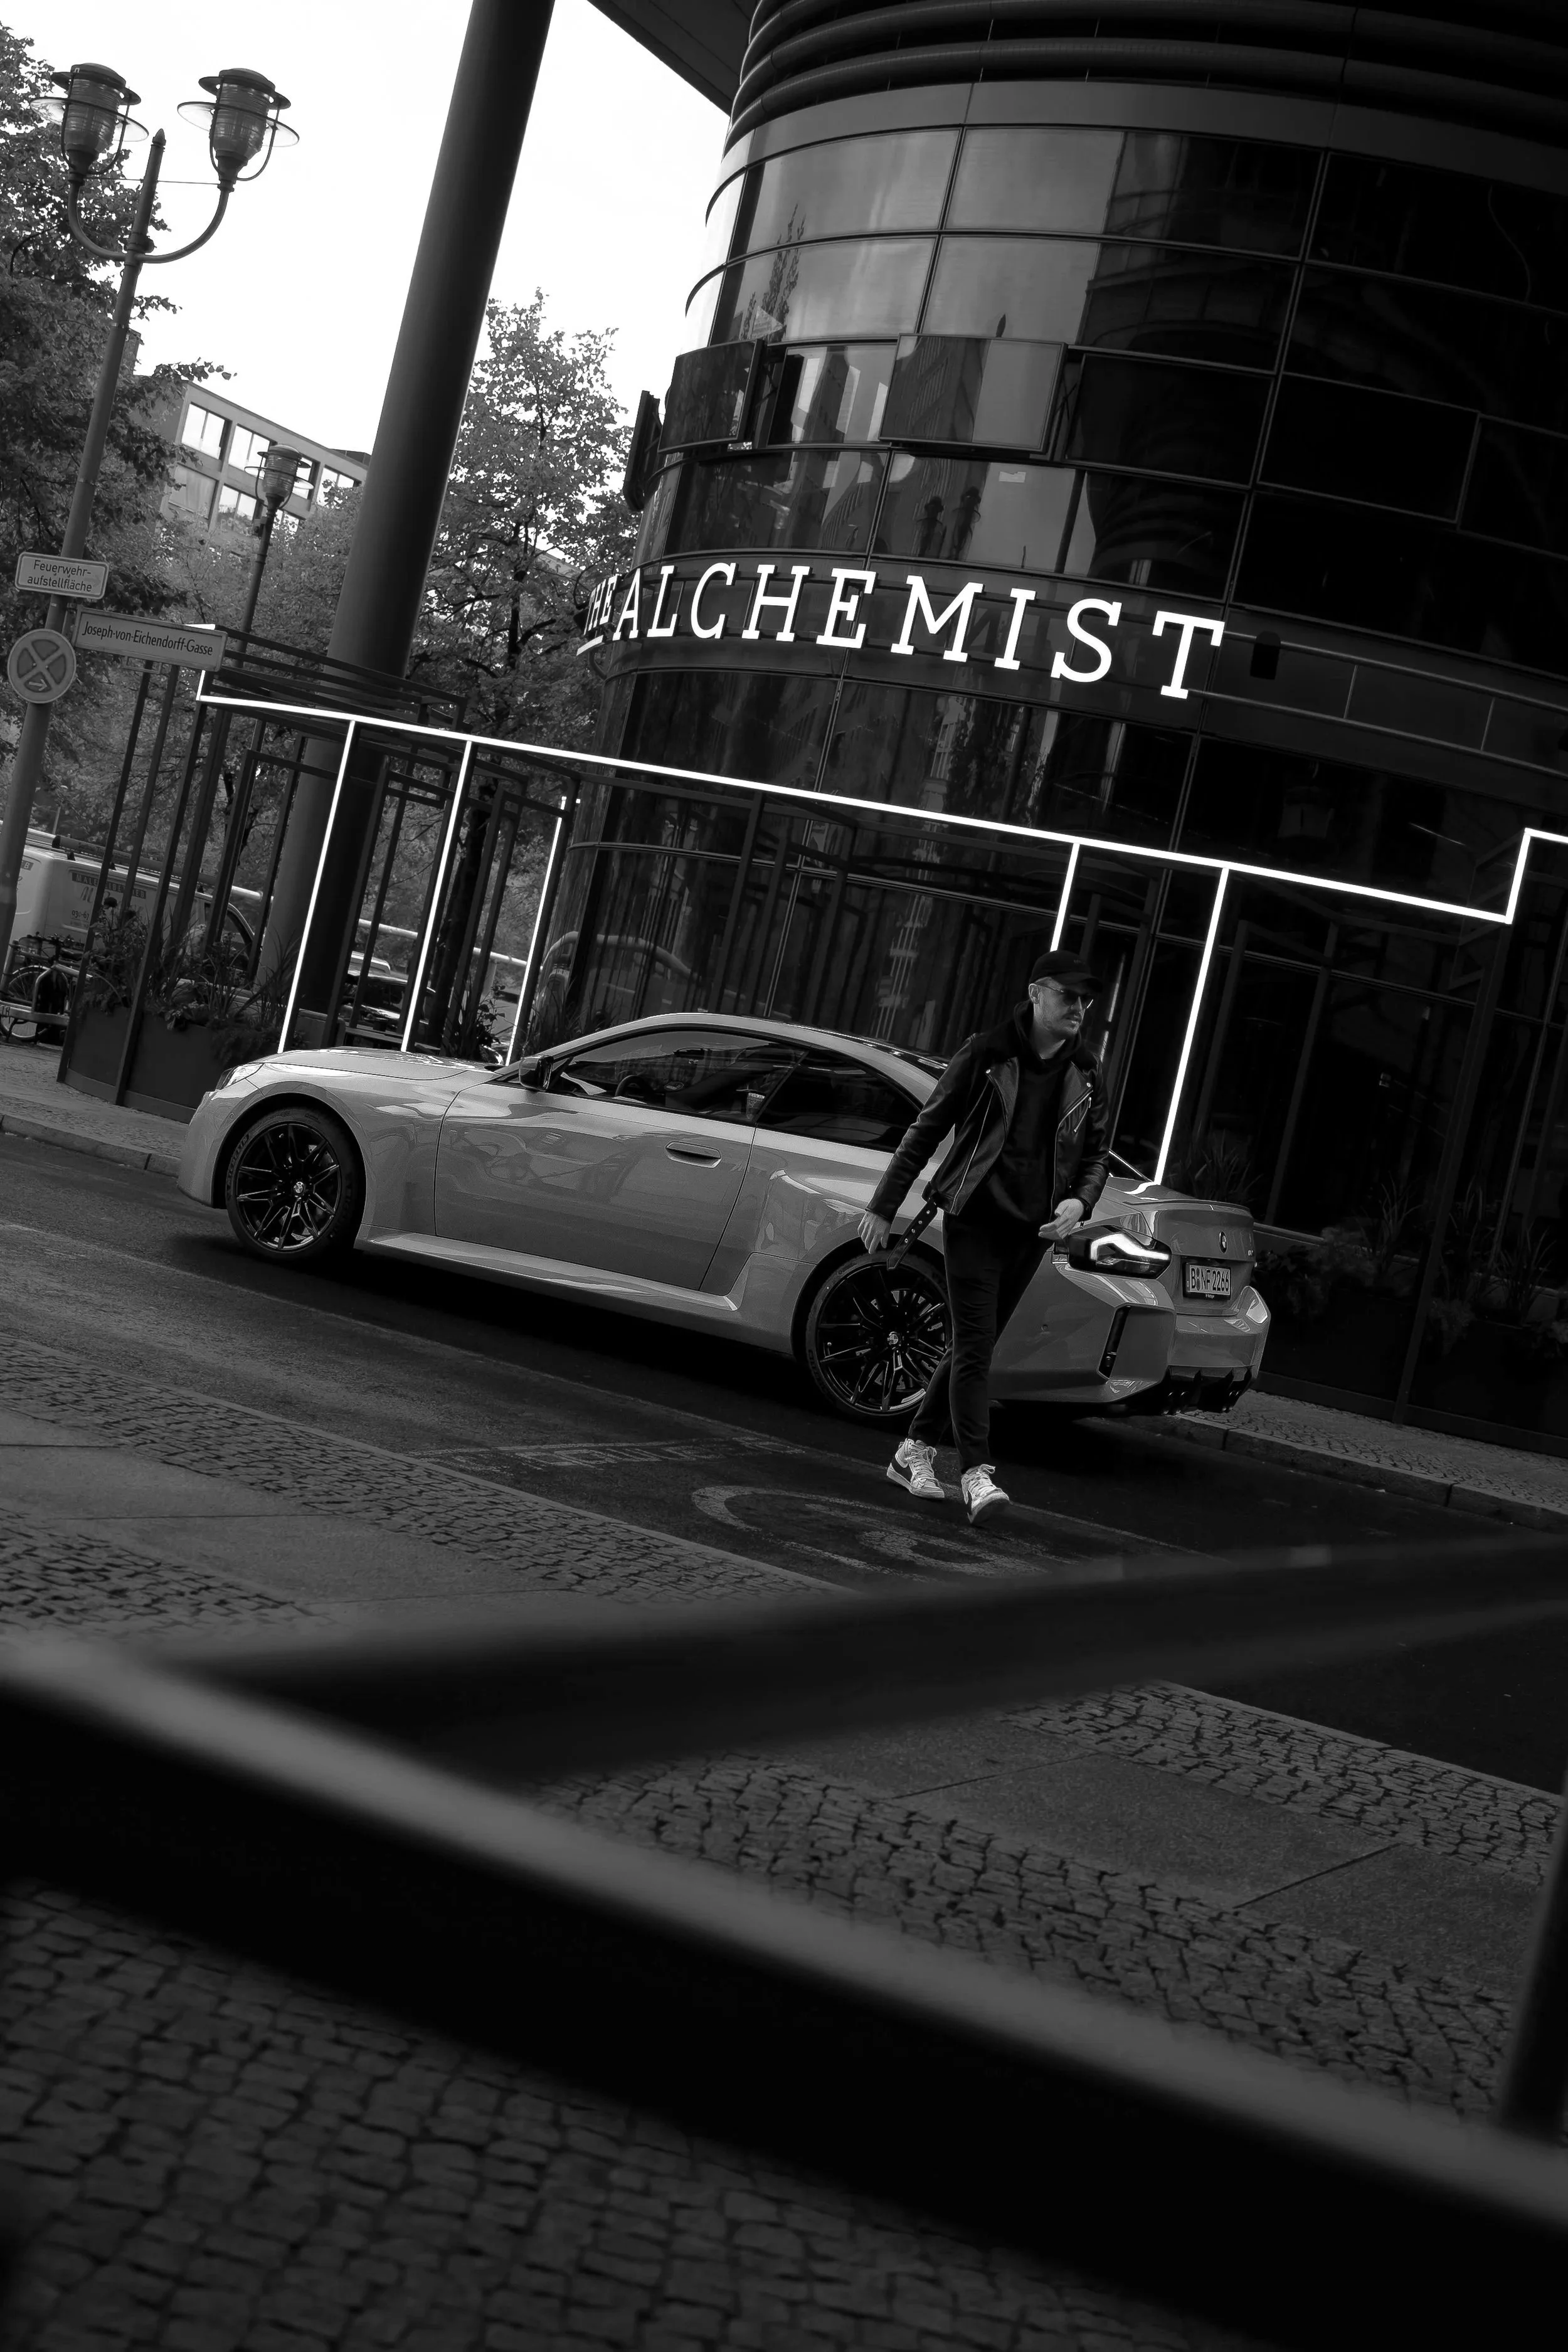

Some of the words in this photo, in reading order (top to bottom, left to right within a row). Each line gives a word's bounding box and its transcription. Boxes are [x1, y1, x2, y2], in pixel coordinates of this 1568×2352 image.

[33, 559, 92, 578] Feuerwehr-
[27, 575, 92, 592] aufstellfläche
[82, 621, 213, 656] Joseph-von-Eichendorff-Gasse
[583, 573, 620, 636] THE
[612, 563, 1225, 699] ALCHEMIST
[1212, 1270, 1229, 1292] 2266
